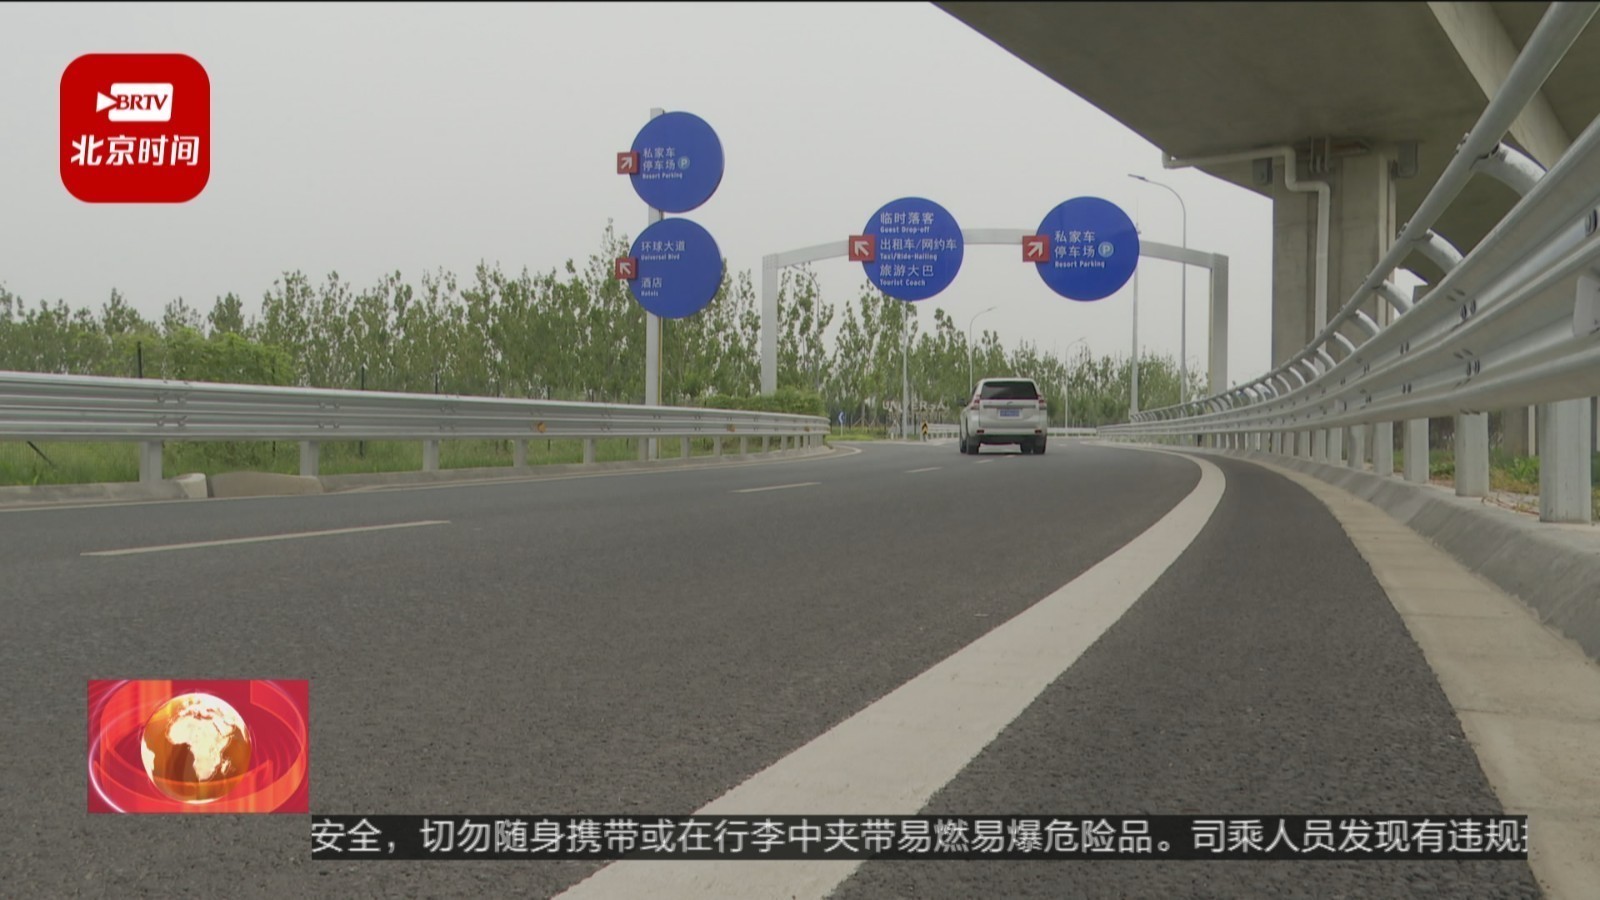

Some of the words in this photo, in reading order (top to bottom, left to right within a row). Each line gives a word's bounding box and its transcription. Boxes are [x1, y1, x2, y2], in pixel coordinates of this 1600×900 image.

[643, 147, 676, 159] 私家车
[643, 159, 676, 172] 停车场
[662, 172, 683, 180] Parking
[880, 211, 934, 225] 临时落客
[901, 226, 930, 234] Drop-off
[1054, 230, 1096, 243] 私家车
[641, 241, 686, 252] 环球大道
[880, 238, 957, 251] 出租车/网约车
[1054, 245, 1095, 258] 停车场
[880, 264, 934, 277] 旅游大巴
[1079, 261, 1105, 269] Parking
[641, 277, 662, 289] 酒店
[905, 279, 926, 287] Coach
